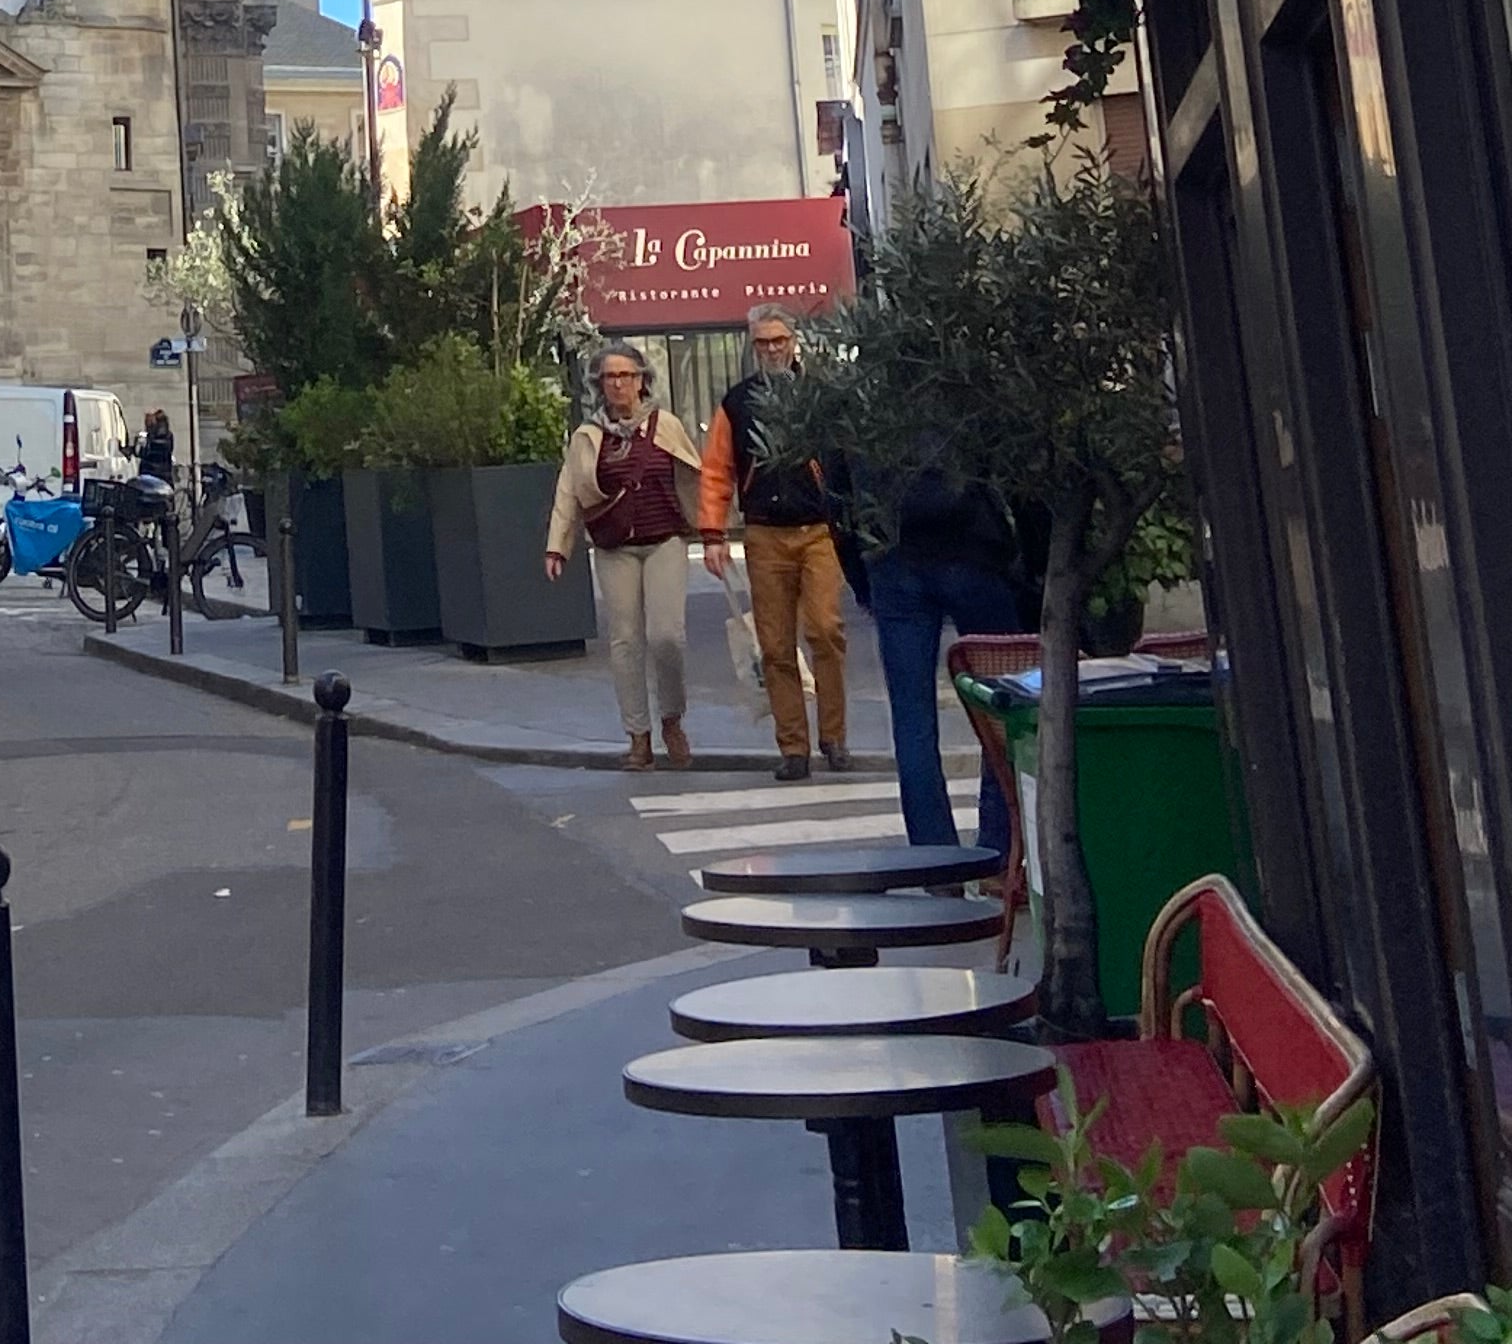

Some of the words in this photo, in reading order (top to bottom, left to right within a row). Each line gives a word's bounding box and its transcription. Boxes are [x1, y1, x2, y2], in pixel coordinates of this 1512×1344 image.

[629, 228, 662, 268] La
[675, 228, 810, 272] Capannina
[617, 287, 721, 303] Ristorante
[745, 281, 830, 299] Pizzeria
